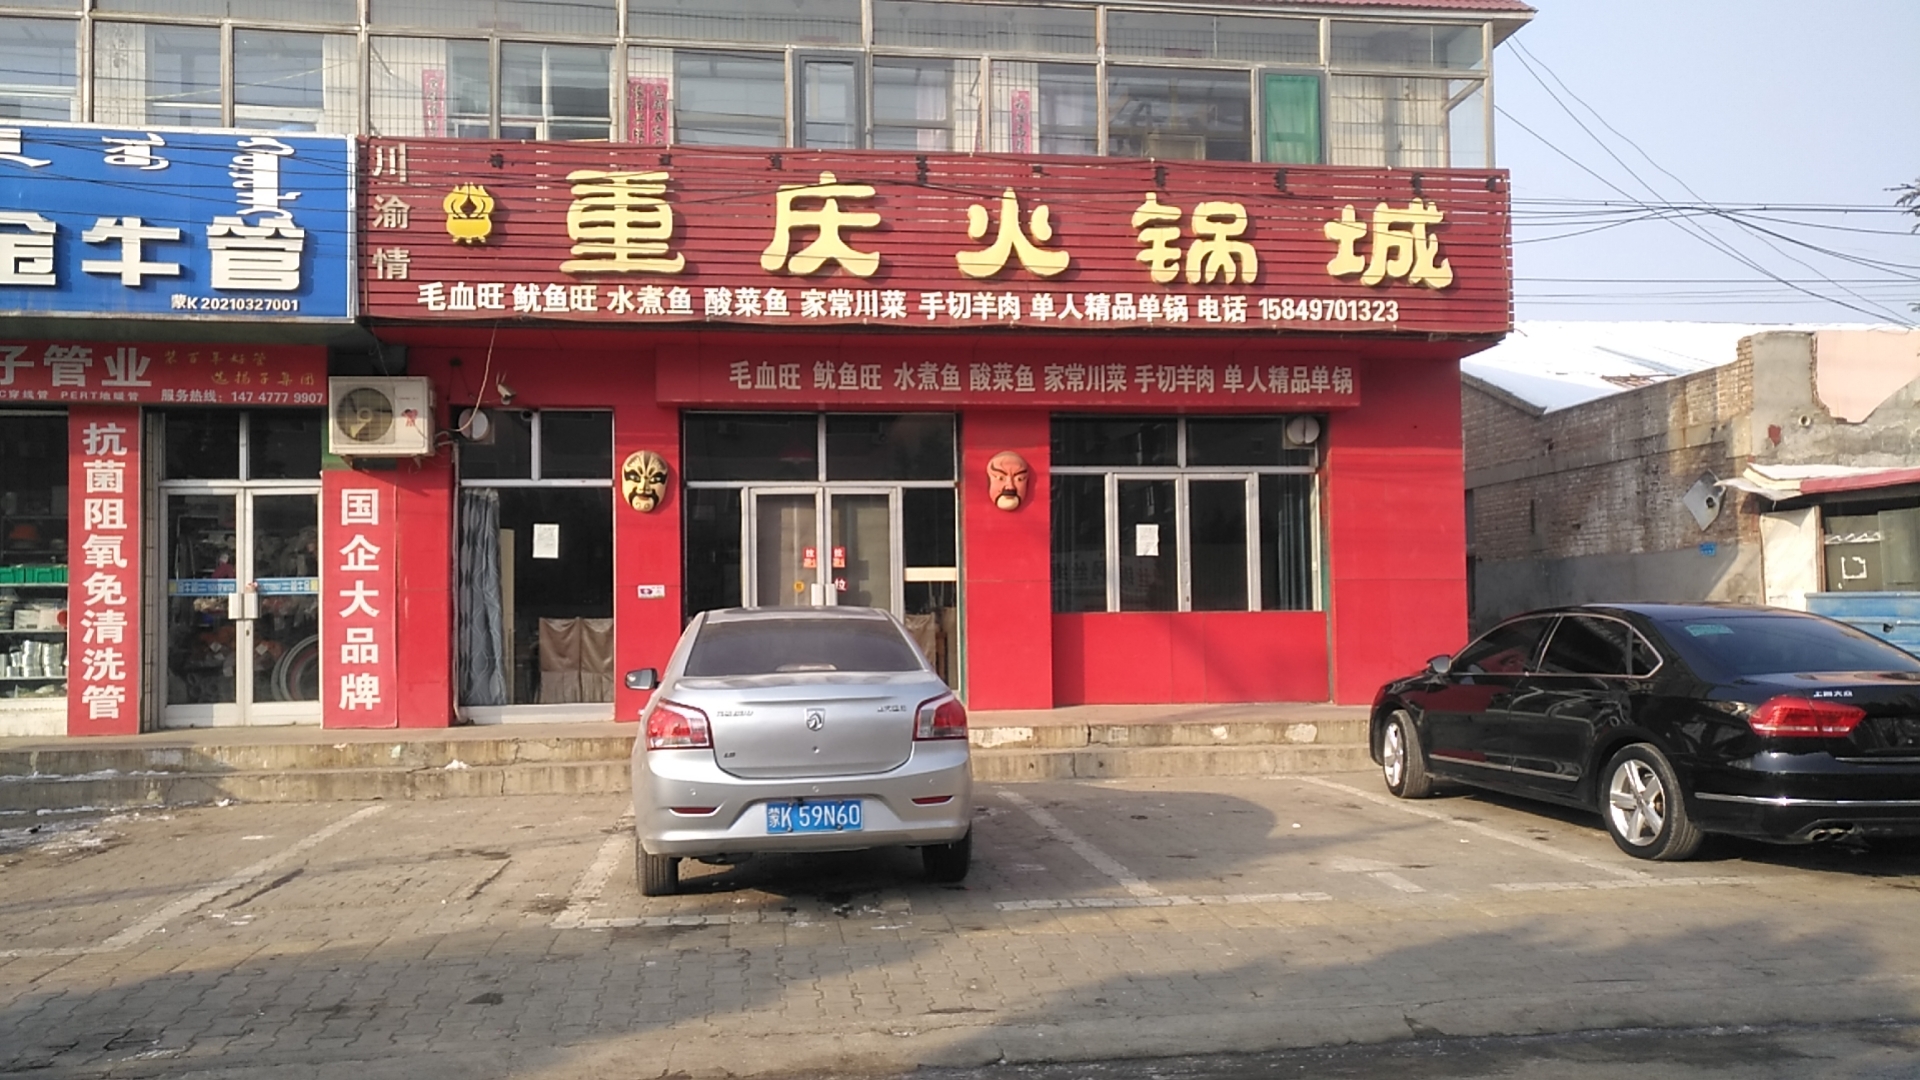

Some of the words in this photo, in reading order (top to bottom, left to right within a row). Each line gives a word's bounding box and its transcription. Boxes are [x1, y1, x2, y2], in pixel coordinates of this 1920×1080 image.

[372, 142, 411, 281] 川渝情
[558, 168, 1455, 289] 重庆火锅城
[201, 296, 298, 311] 20210327001
[417, 282, 505, 312] 毛血旺
[512, 283, 598, 313] 鱿鱼旺
[606, 287, 694, 316] 水煮鱼
[704, 288, 790, 318] 酸菜鱼
[799, 288, 908, 319] 家常川菜
[918, 291, 1022, 322] 手切羊肉
[1029, 293, 1189, 324] 单人精品单锅
[1197, 296, 1248, 324] 电话
[1258, 298, 1399, 323] 15849701323
[231, 391, 252, 402] 147
[258, 392, 289, 404] 4777
[293, 392, 323, 404] 9907
[729, 361, 801, 390] 毛血旺
[813, 361, 882, 391] 鱿鱼旺
[893, 362, 962, 391] 水煮鱼
[969, 363, 1036, 392] 酸菜鱼
[1044, 363, 1128, 393] 家常川菜
[1134, 364, 1215, 394] 手切羊肉
[1223, 365, 1353, 395] 单人精品单锅
[81, 422, 128, 719] 抗菌阻氧免清洗管
[339, 488, 381, 711] 国企大品牌
[799, 803, 861, 828] 59N60
